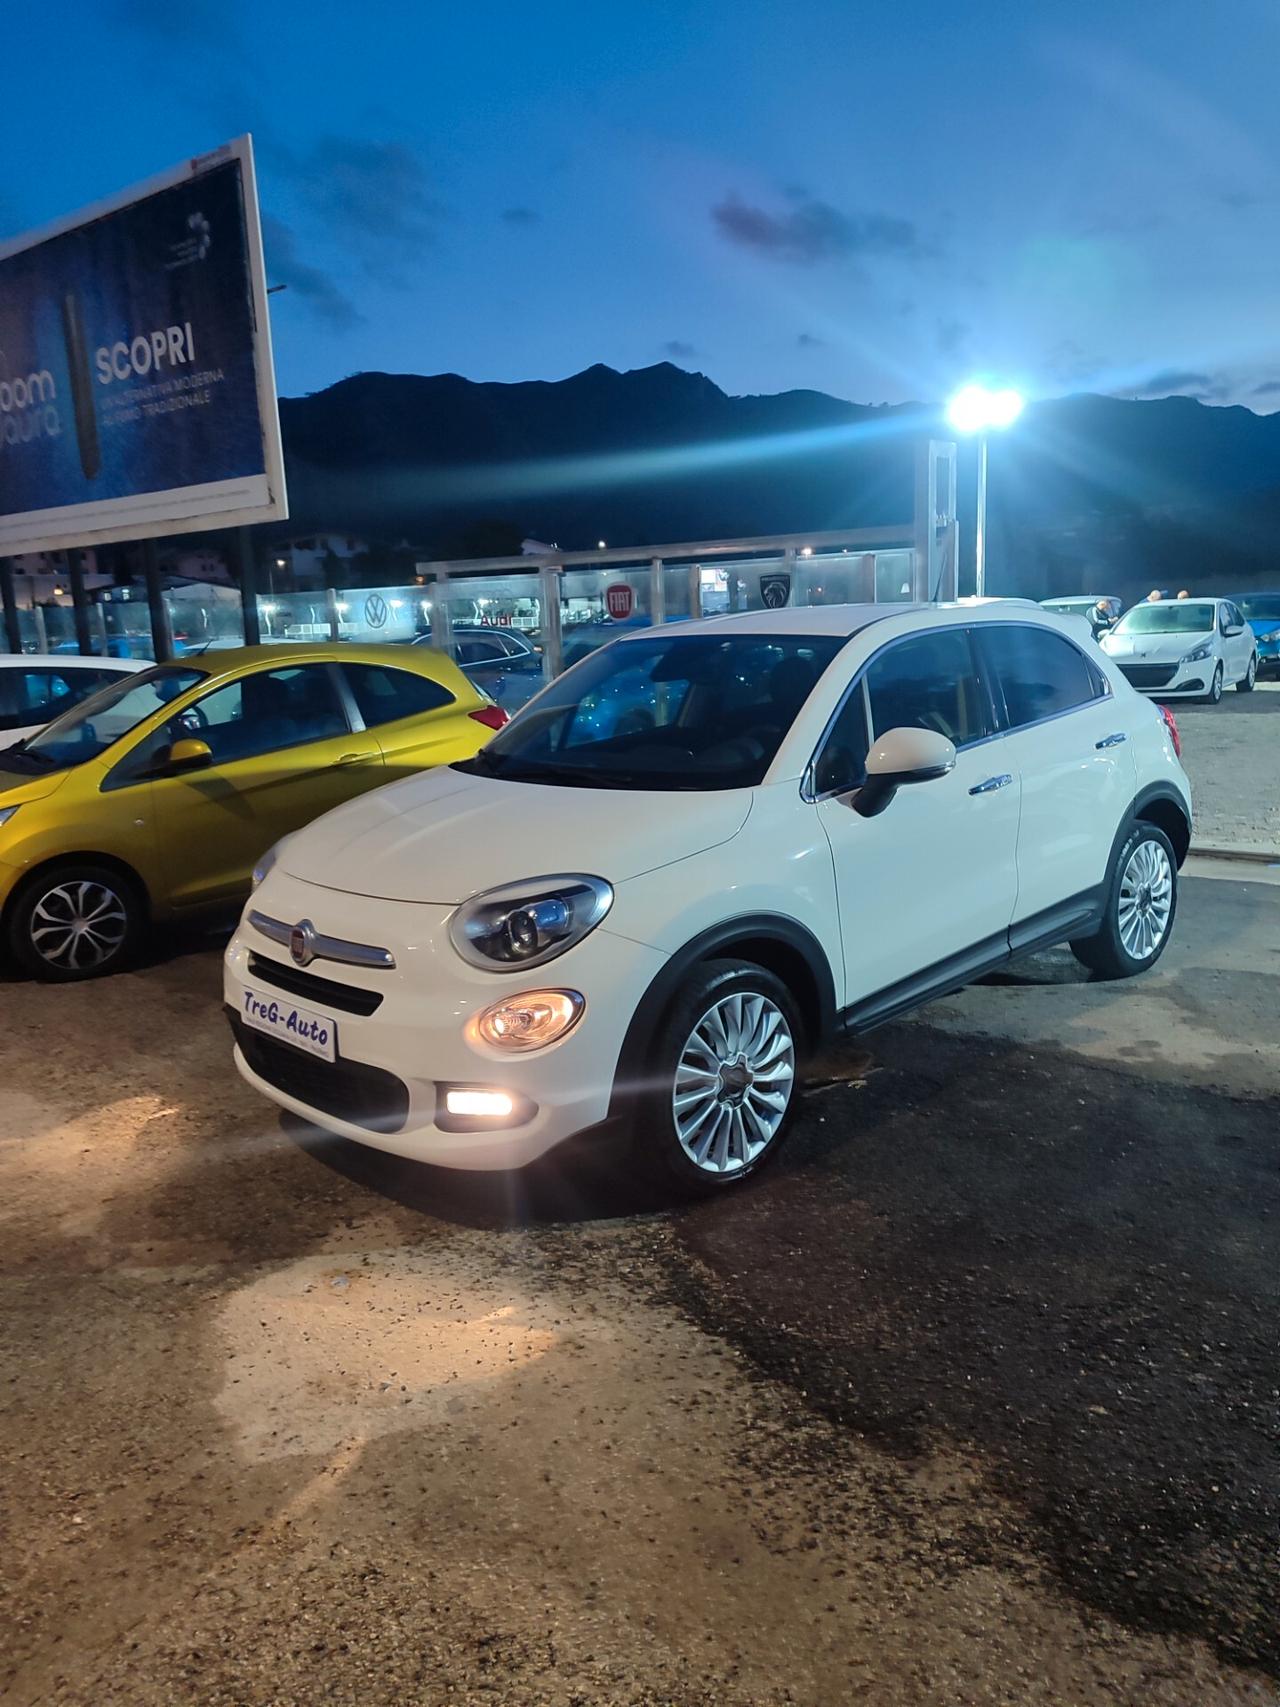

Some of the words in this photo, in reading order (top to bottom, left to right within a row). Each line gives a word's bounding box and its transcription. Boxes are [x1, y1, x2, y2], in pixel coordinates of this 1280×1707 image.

[95, 321, 195, 385] SCOPRI
[174, 368, 224, 391] MODERNA
[609, 592, 630, 613] FIAT
[480, 613, 513, 627] Audi
[244, 991, 328, 1045] TreG-Auto
